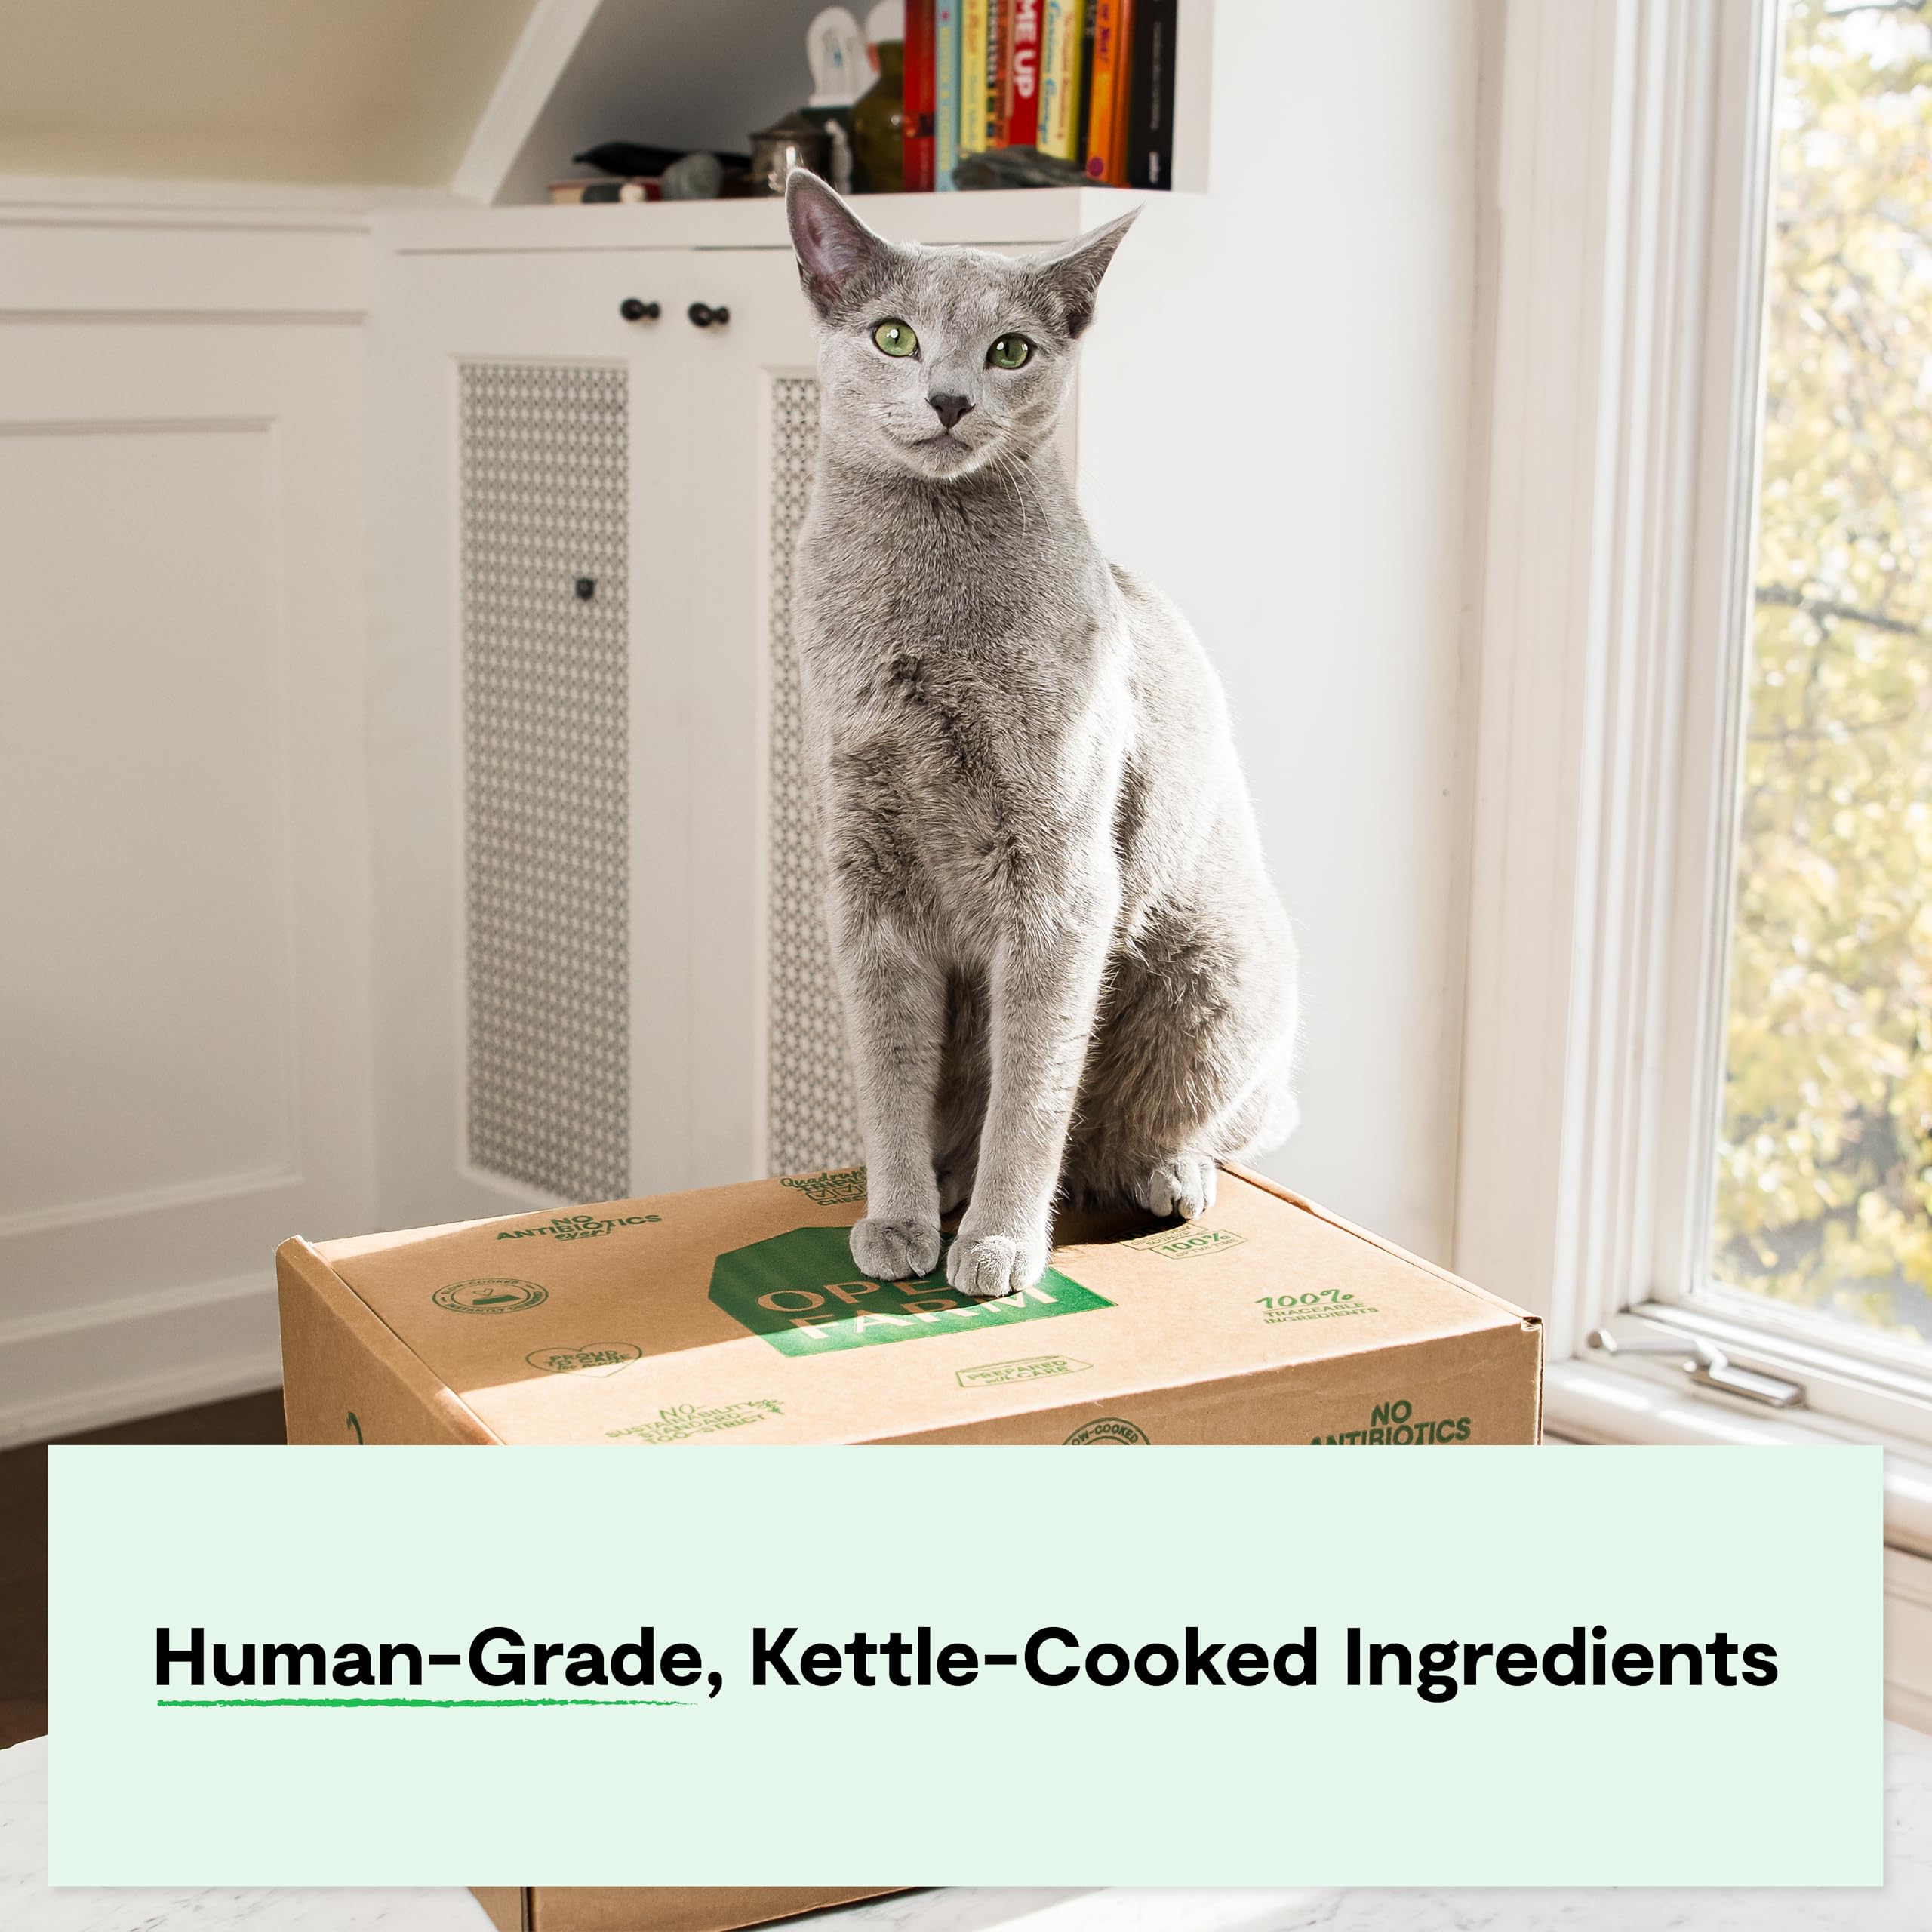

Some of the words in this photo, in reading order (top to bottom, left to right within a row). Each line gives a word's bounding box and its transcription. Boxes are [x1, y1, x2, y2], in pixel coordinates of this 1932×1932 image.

[1014, 50, 1035, 98] UP
[780, 1166, 866, 1188] Quadrup
[817, 1195, 866, 1206] CHEC
[497, 1214, 663, 1240] ANTIBIOTICS
[550, 1215, 594, 1226] NO
[1161, 1232, 1231, 1253] 100%
[757, 1280, 953, 1312] OPE
[1254, 1289, 1355, 1309] 100%
[789, 1286, 1058, 1340] FARM
[1263, 1302, 1366, 1318] TRACEABLE
[1264, 1307, 1380, 1324] INGREDIENTS
[967, 1360, 1068, 1380] PREPARED
[1017, 1366, 1072, 1378] CARE
[1370, 1399, 1412, 1427] NO
[1072, 1423, 1139, 1445] OW-COOKED
